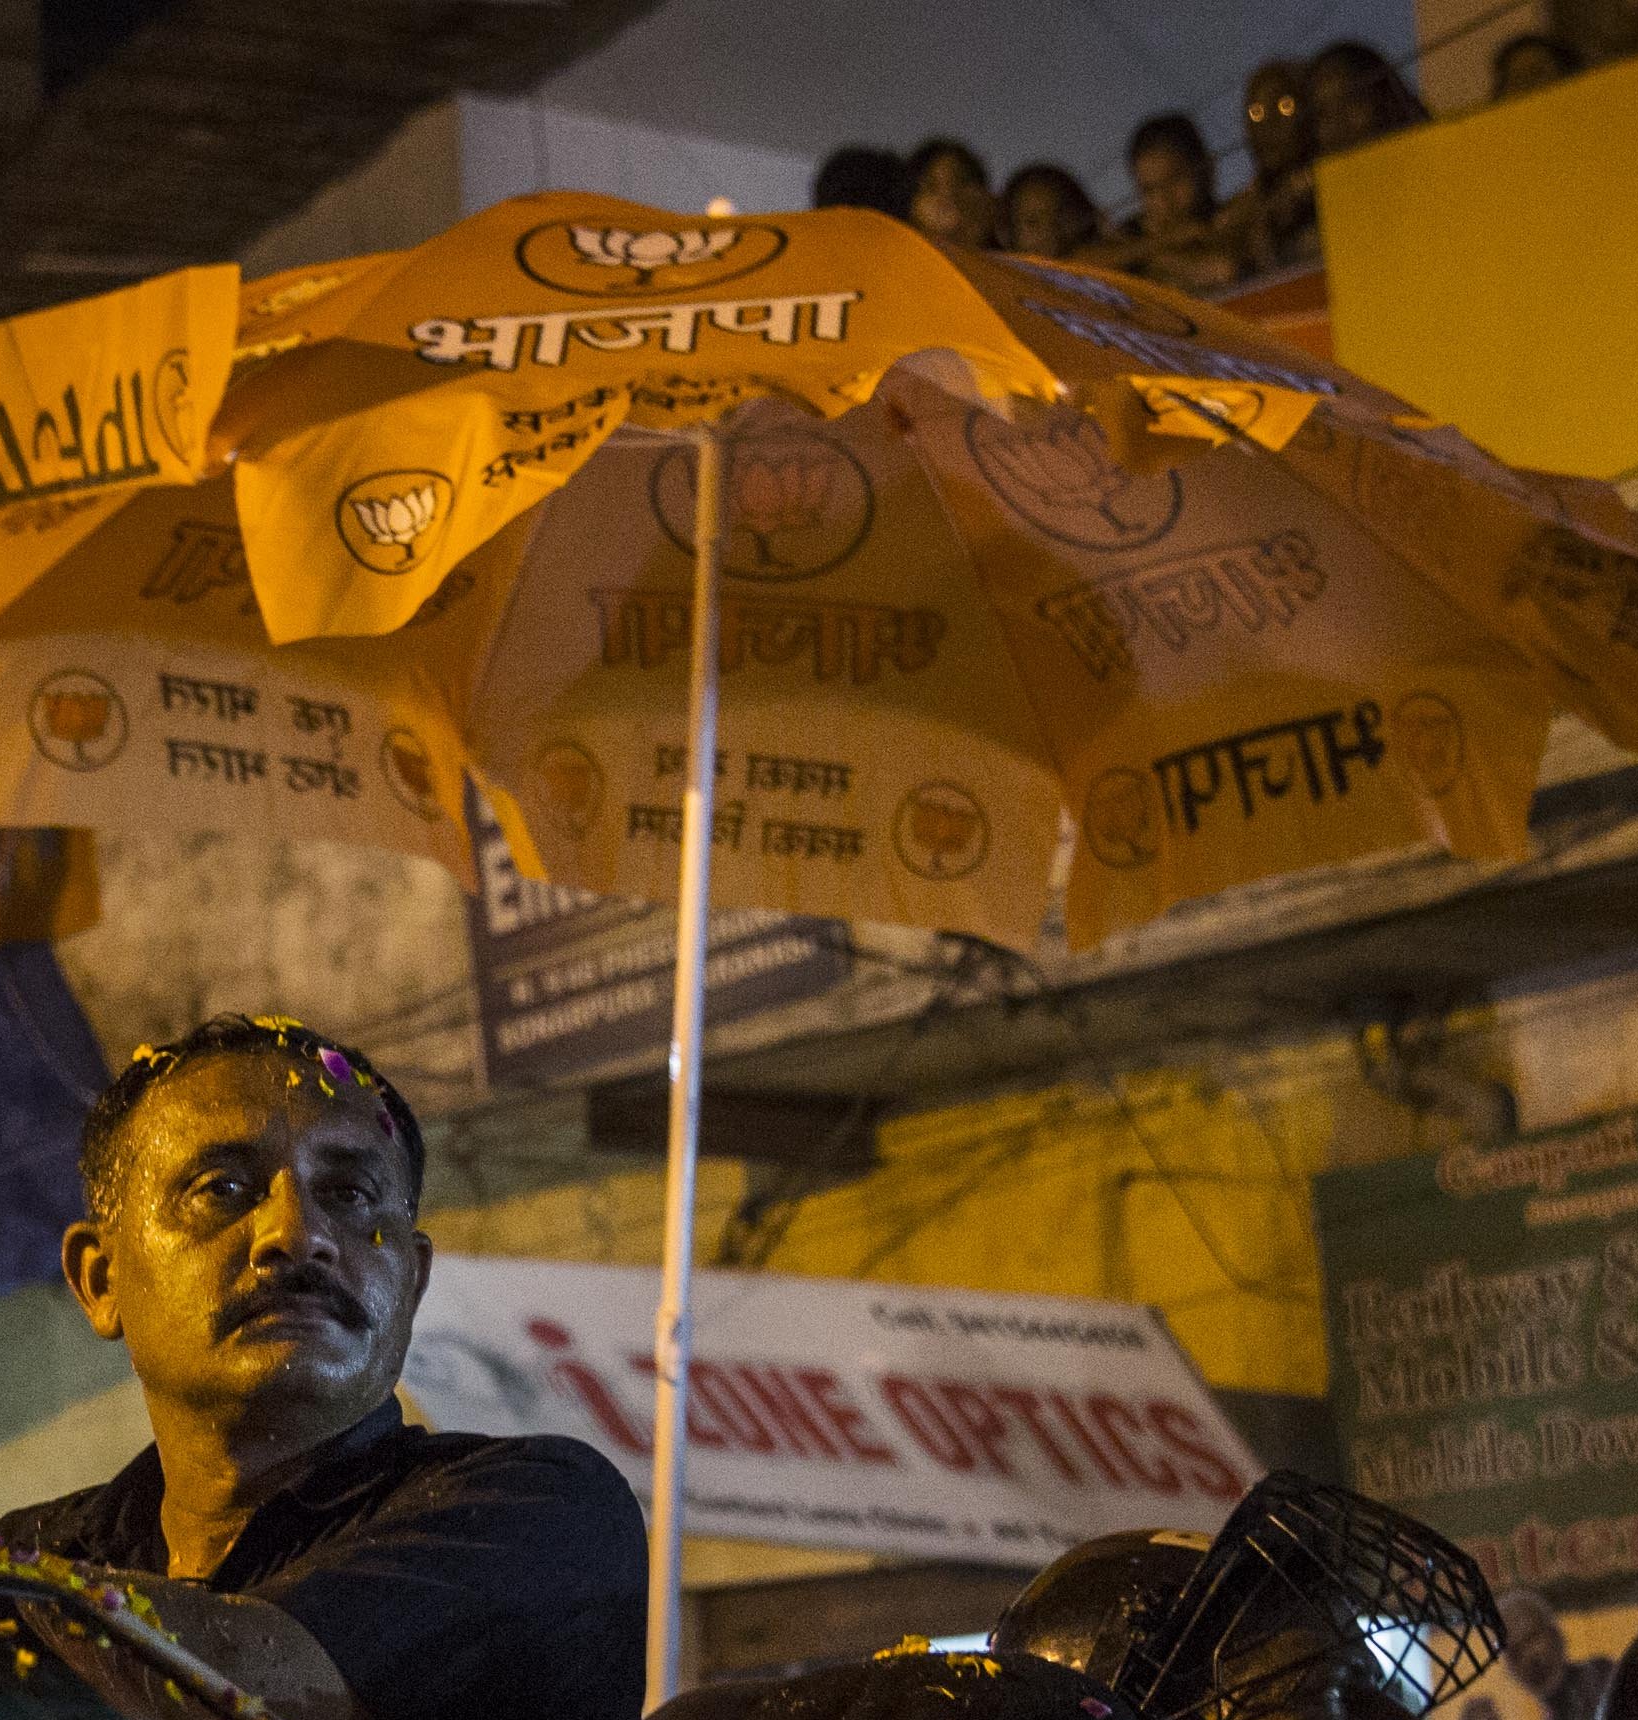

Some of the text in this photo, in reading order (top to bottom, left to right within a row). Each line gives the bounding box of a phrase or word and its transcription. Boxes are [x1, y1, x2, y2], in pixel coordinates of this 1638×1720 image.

[410, 290, 864, 372] भाजपा
[1342, 1255, 1596, 1346] Railway
[1355, 1317, 1586, 1420] Mobile
[879, 1372, 1245, 1502] OPTICS
[1351, 1412, 1536, 1499] Mobile
